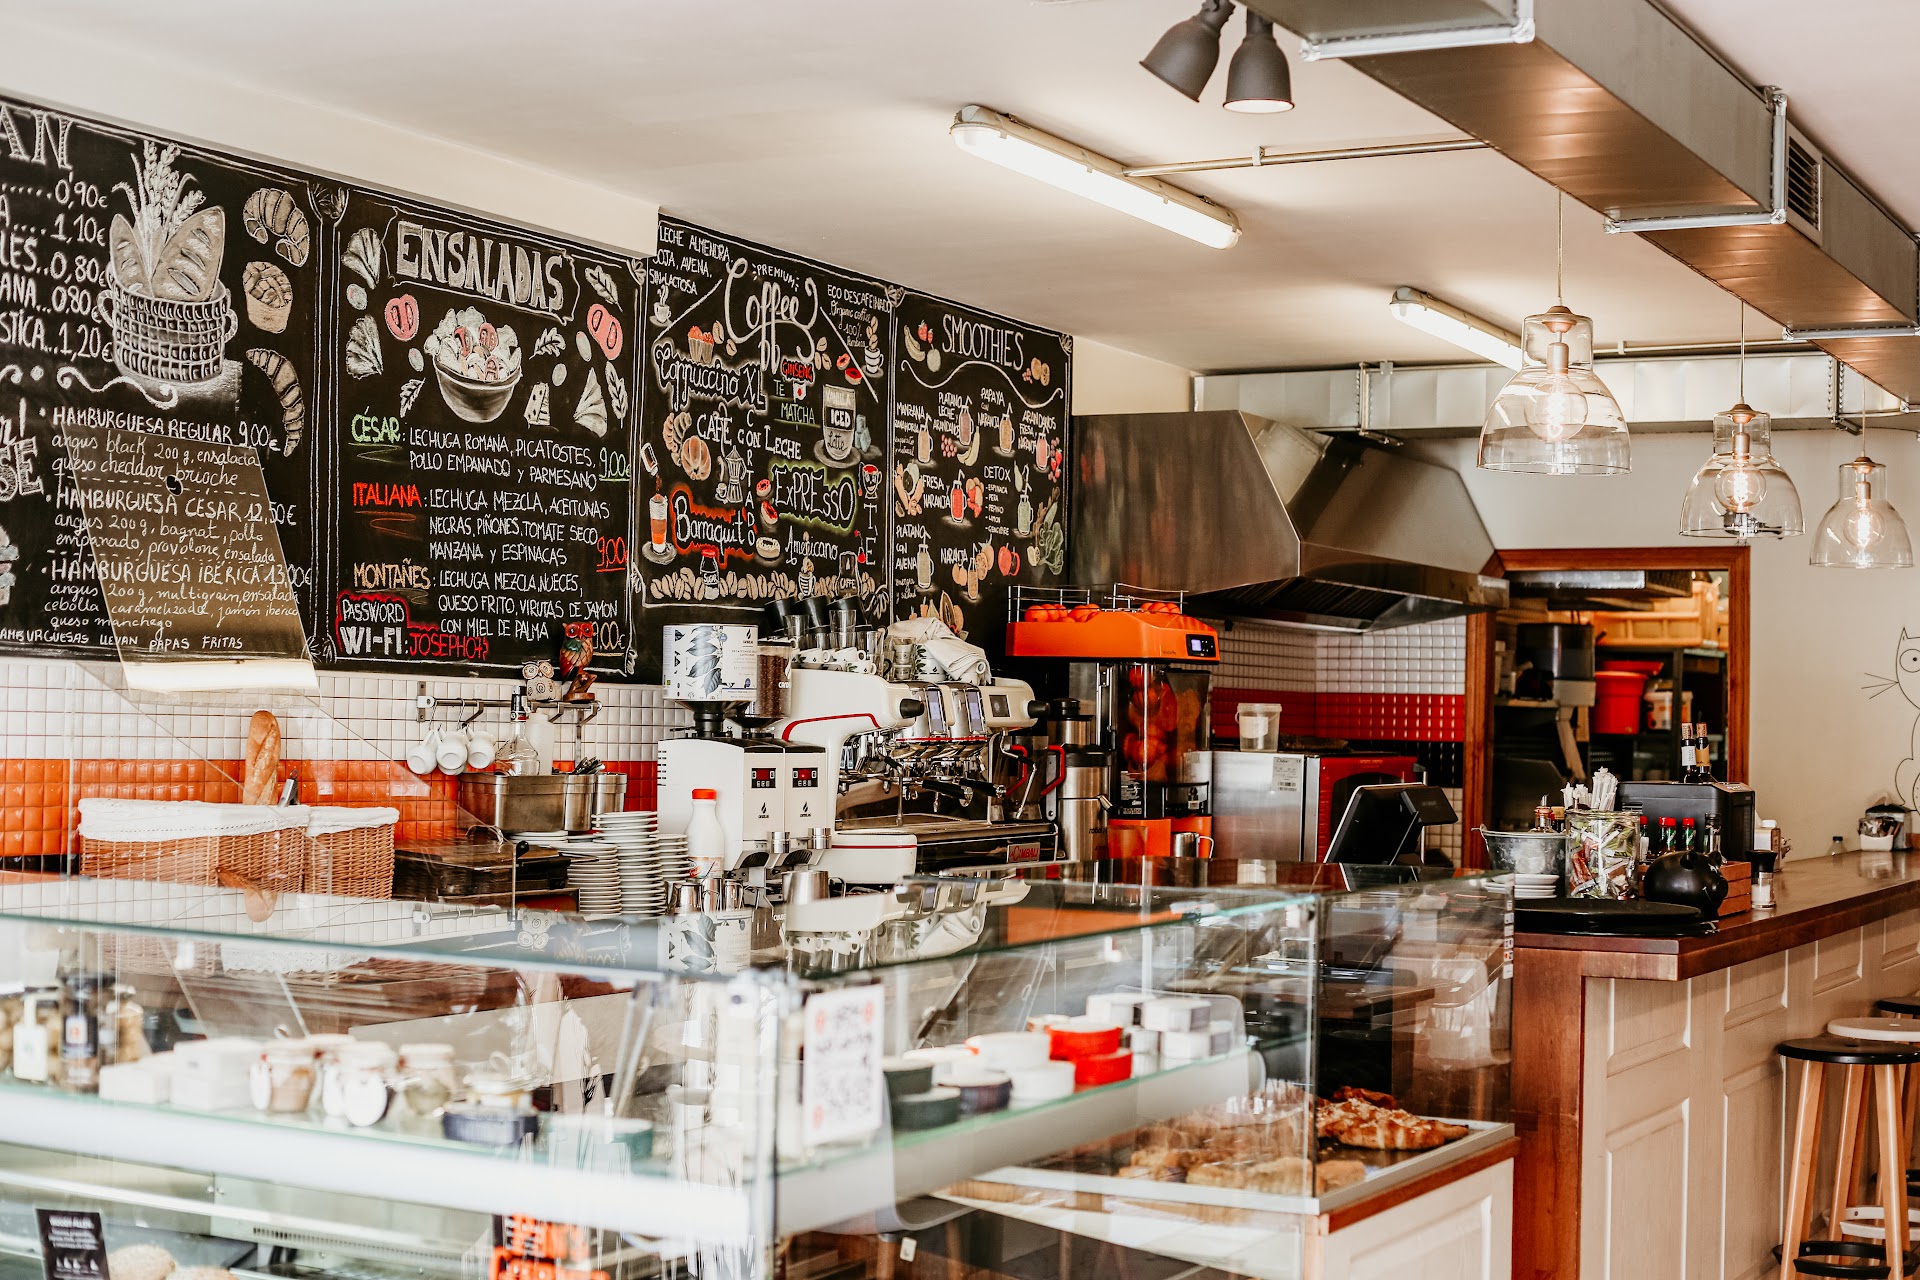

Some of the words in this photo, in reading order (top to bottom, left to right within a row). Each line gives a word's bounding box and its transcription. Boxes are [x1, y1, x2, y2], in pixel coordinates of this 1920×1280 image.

[659, 225, 685, 247] LECHE
[396, 219, 564, 312] ENSALADAS
[757, 263, 796, 288] PREMIUM
[827, 284, 842, 299] ECO
[724, 257, 819, 375] Coffee
[941, 313, 1024, 371] SMOOTHIES
[655, 347, 740, 412] Cappuccino
[742, 367, 765, 405] XL
[980, 387, 1006, 408] PAPAYA
[53, 406, 164, 435] HAMBURGUESA
[168, 418, 233, 445] REGULAR
[780, 402, 816, 425] MATCHA
[830, 408, 852, 428] ICED
[51, 434, 99, 460] angus
[409, 427, 461, 449] LECHUGA
[51, 458, 96, 481] queso
[175, 462, 238, 486] brioche
[409, 450, 443, 470] POLLO
[447, 453, 511, 477] EMPANADO
[529, 465, 597, 492] PARMESANO
[921, 474, 945, 490] FRESA
[983, 465, 1012, 483] DETOX
[56, 486, 177, 515] HAMBURGUESA
[429, 488, 488, 511] LECHUGA
[549, 496, 610, 519] ACEITUNAS
[923, 493, 951, 510] NARANJA
[54, 513, 103, 536] angus
[229, 523, 263, 546] pollo
[522, 520, 565, 542] TOMATE
[569, 524, 598, 545] SECO
[224, 542, 276, 562] ensalada
[429, 541, 484, 562] MANZANA
[502, 542, 567, 568] ESPINACAS
[784, 525, 839, 566] Americano
[51, 558, 191, 583] HAMBURGUESA
[894, 556, 918, 571] AVENA
[439, 569, 490, 590] LECHUGA
[44, 597, 99, 612] cebolla
[50, 584, 99, 602] angus
[342, 598, 405, 623] PASSWORD
[438, 594, 479, 611] QUESO
[520, 599, 564, 619] VIRUTAS
[568, 601, 582, 618] DE
[50, 617, 89, 631] queso
[94, 615, 173, 640] manchego
[440, 618, 462, 633] CON
[466, 617, 493, 637] MIEL
[497, 619, 511, 637] DE
[515, 619, 549, 641] PALMA
[149, 637, 190, 651] PAPAS
